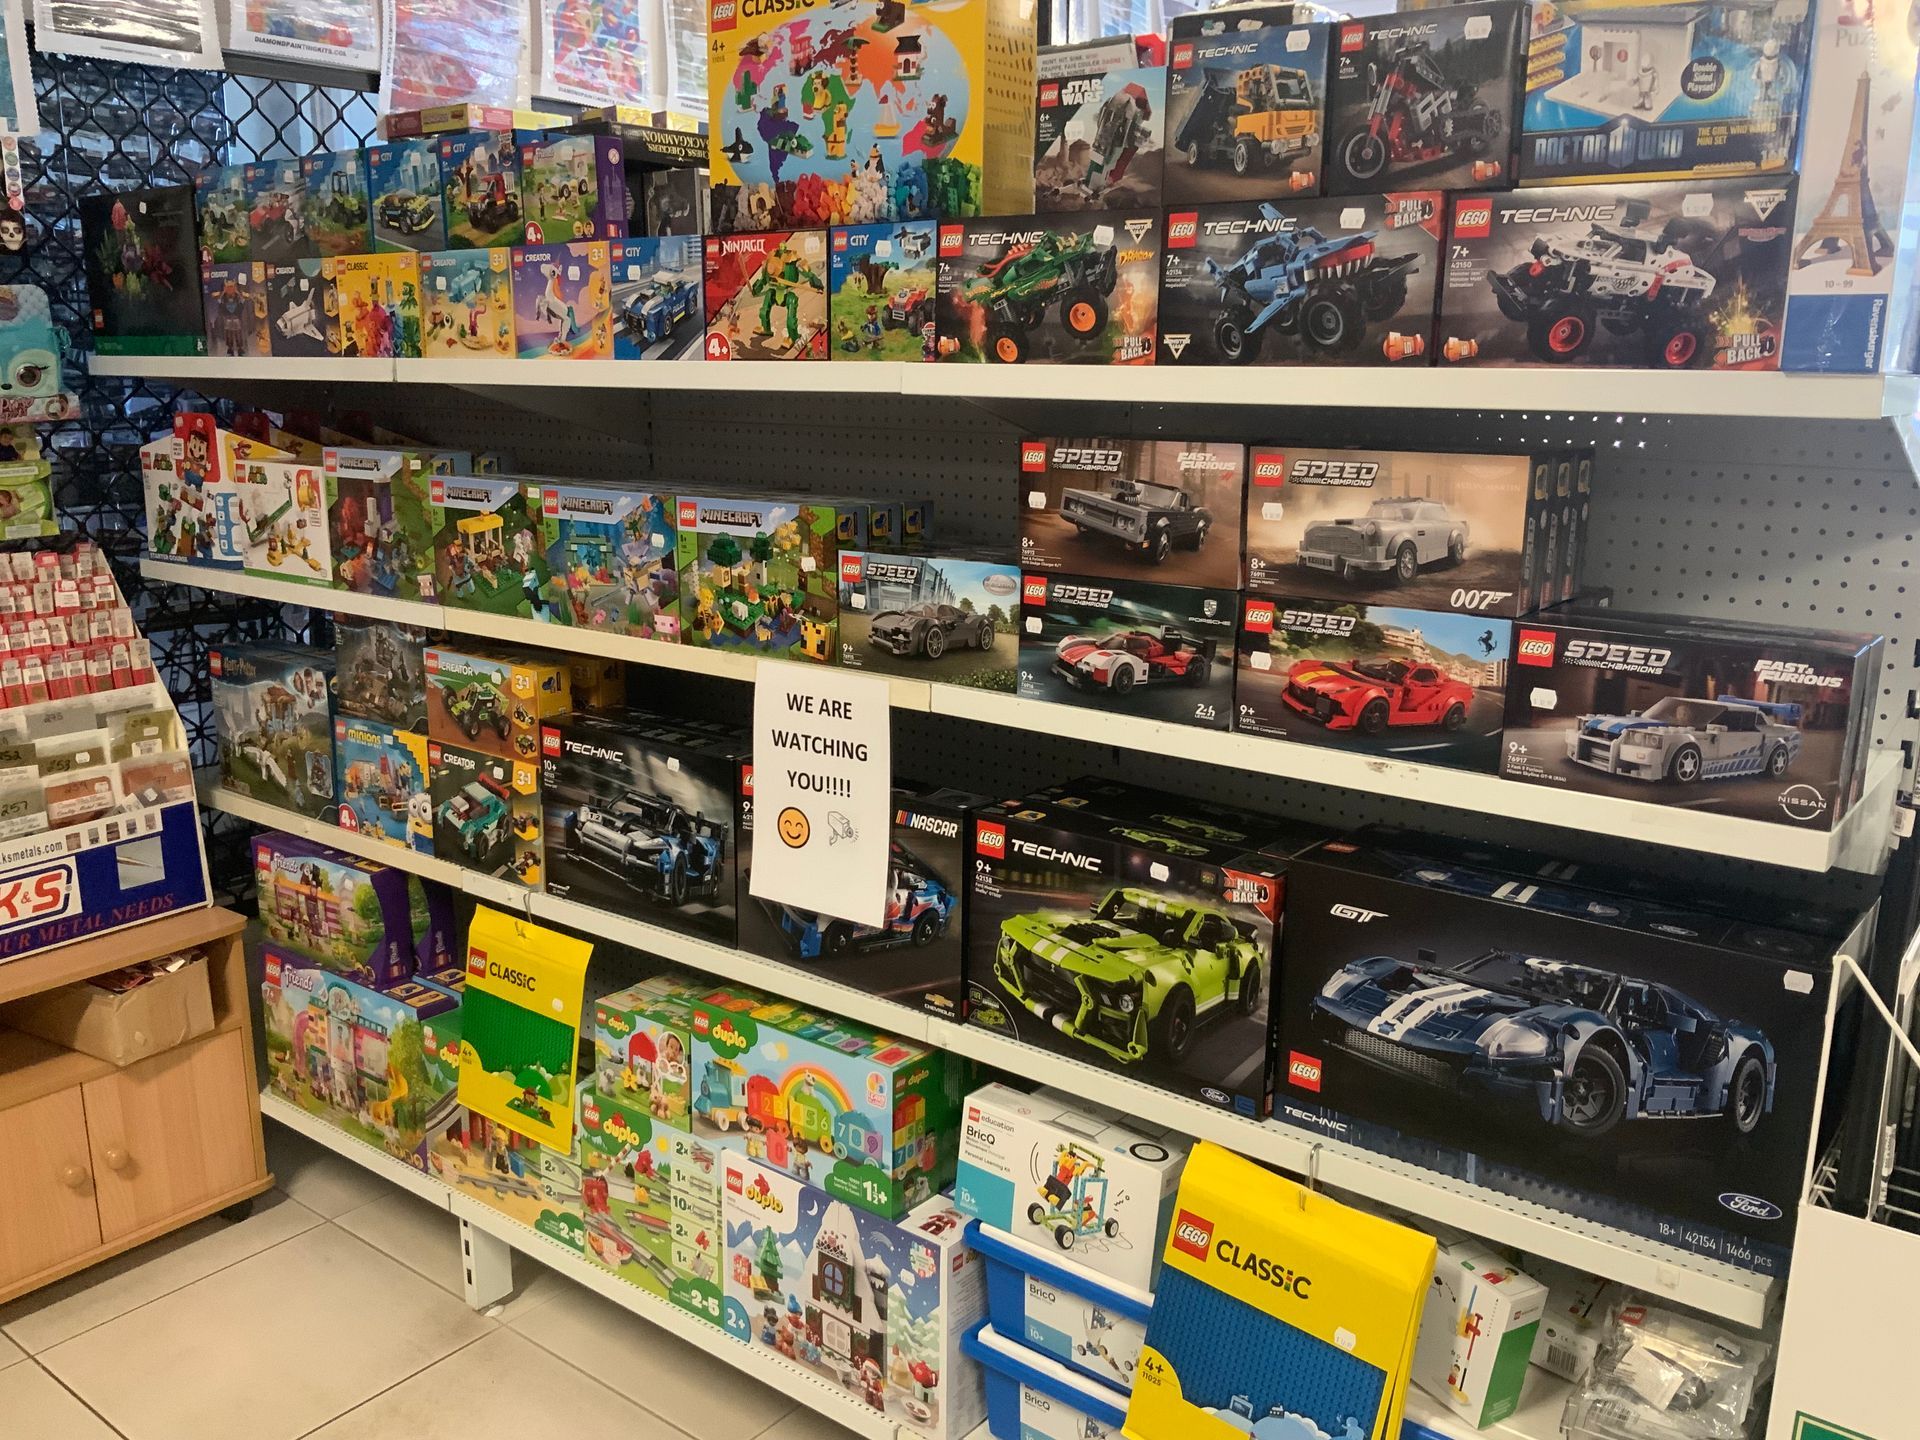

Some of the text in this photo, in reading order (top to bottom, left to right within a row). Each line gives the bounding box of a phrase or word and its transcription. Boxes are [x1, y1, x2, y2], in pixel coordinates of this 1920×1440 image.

[713, 3, 735, 19] LEGO
[1342, 32, 1362, 44] LEGO
[1369, 24, 1438, 39] TECHNIC
[712, 39, 726, 53] 4+
[1197, 44, 1258, 58] TECHNIC
[1174, 49, 1192, 61] LEGO
[1339, 57, 1351, 67] 7+
[1062, 79, 1104, 93] STAR
[1041, 90, 1058, 100] LEGO
[1062, 91, 1104, 106] WARS
[1040, 113, 1050, 122] 6+
[642, 130, 709, 149] ACKGAMMON
[1534, 129, 1684, 167] DOCTOR WHO
[1399, 200, 1422, 213] PULL
[1500, 205, 1616, 223] TECHNIC
[1204, 217, 1297, 234] TECHNIC
[1393, 212, 1422, 229] BACK
[1457, 210, 1490, 228] LEGO
[1169, 222, 1195, 238] LEGO
[850, 233, 868, 247] CITY
[942, 234, 961, 247] LEGO
[968, 231, 1044, 247] TECHNIC
[625, 246, 641, 259] CITY
[721, 239, 766, 255] NINJAGO
[1452, 245, 1469, 259] 7+
[525, 253, 551, 263] CREATOR
[1166, 254, 1181, 267] 7+
[1450, 261, 1473, 269] 42150
[939, 263, 950, 274] 7+
[1864, 298, 1883, 369] Ravensburger
[708, 336, 728, 358] 4+
[1123, 336, 1143, 348] PULL
[1732, 335, 1762, 350] PULL
[1121, 346, 1144, 361] BACK
[1726, 346, 1763, 365] BACK
[339, 456, 382, 471] MINECRAFT
[1024, 451, 1044, 463] LEGO
[1052, 448, 1122, 466] SPEED
[1076, 463, 1118, 472] CHAMPIONS
[1180, 460, 1236, 471] FURIOUS
[1256, 463, 1282, 477] LEGO
[1291, 459, 1378, 480] SPEED
[1320, 476, 1374, 487] CHAMPIONS
[446, 486, 493, 502] MINECRAFT
[560, 496, 614, 514] MINECRAFT
[679, 507, 763, 527] LEGO MINECRAFT
[1021, 537, 1035, 547] 8+
[843, 563, 860, 574] LEGO
[866, 563, 918, 579] SPEED
[1250, 558, 1266, 570] 8+
[1025, 585, 1045, 597] LEGO
[1052, 584, 1113, 602] SPEED
[1188, 616, 1231, 626] PORSCHE
[1247, 609, 1272, 623] LEGO
[1280, 609, 1356, 631] SPEED
[1306, 626, 1350, 637] CHAMPIONS
[842, 643, 853, 653] 9+
[1519, 639, 1552, 656] LEGO
[1564, 639, 1672, 667] SPEED
[441, 662, 474, 676] CREATOR
[1600, 661, 1664, 675] CHAMPIONS
[1021, 671, 1033, 681] 9+
[1756, 670, 1844, 688] FURIOUS
[787, 692, 853, 720] WE ARE
[1240, 704, 1255, 716] 9+
[543, 735, 560, 748] LEGO
[771, 728, 868, 762] WATCHING
[1508, 742, 1528, 755] 9+
[564, 740, 624, 763] TECHNIC
[443, 753, 476, 770] CREATOR
[543, 759, 557, 771] 10+
[787, 769, 852, 798] YOU!!!!
[1, 800, 29, 817] 257
[1777, 795, 1828, 810] NISSAN
[909, 813, 959, 839] NASCAR
[979, 831, 1004, 849] LEGO
[271, 851, 300, 874] Friends
[1011, 838, 1102, 872] TECHNIC
[975, 859, 992, 873] 9+
[1237, 879, 1258, 892] PULL
[1232, 889, 1260, 904] BACK
[38, 912, 105, 941] METAL
[110, 893, 175, 924] NEEDS
[1329, 903, 1390, 923] GT
[266, 963, 281, 978] LEGO
[468, 955, 487, 971] LEGO
[283, 964, 314, 992] Friends
[924, 1002, 955, 1018] CHEVROLET
[608, 1018, 630, 1033] duplo
[694, 1016, 709, 1029] LEGO
[712, 1025, 748, 1049] duplo
[1290, 1059, 1321, 1081] LEGO
[1204, 1088, 1229, 1103] Ford
[583, 1106, 600, 1123] LEGO
[1283, 1105, 1348, 1132] TECHNIC
[980, 1114, 1015, 1133] education
[602, 1117, 640, 1146] duplo
[966, 1125, 996, 1146] BricQ
[675, 1141, 689, 1156] 2x
[675, 1169, 686, 1183] 1x
[727, 1175, 742, 1188] LEGO
[672, 1195, 692, 1212] 10x
[745, 1184, 785, 1213] duplo
[961, 1190, 976, 1204] 10+
[1728, 1194, 1771, 1217] Ford
[560, 1221, 583, 1245] 2-5
[675, 1223, 689, 1237] 2x
[1175, 1222, 1210, 1248] LEGO
[1658, 1222, 1773, 1268] 18+ 42154 1466 pcs
[676, 1250, 687, 1263] 1x
[1029, 1283, 1056, 1303] BricQ
[691, 1289, 719, 1317] 2-5
[727, 1311, 746, 1330] 2+
[1030, 1328, 1045, 1342] 10+
[1144, 1356, 1165, 1374] 4+
[1142, 1370, 1162, 1387] 11025
[1024, 1391, 1051, 1411] BricQ
